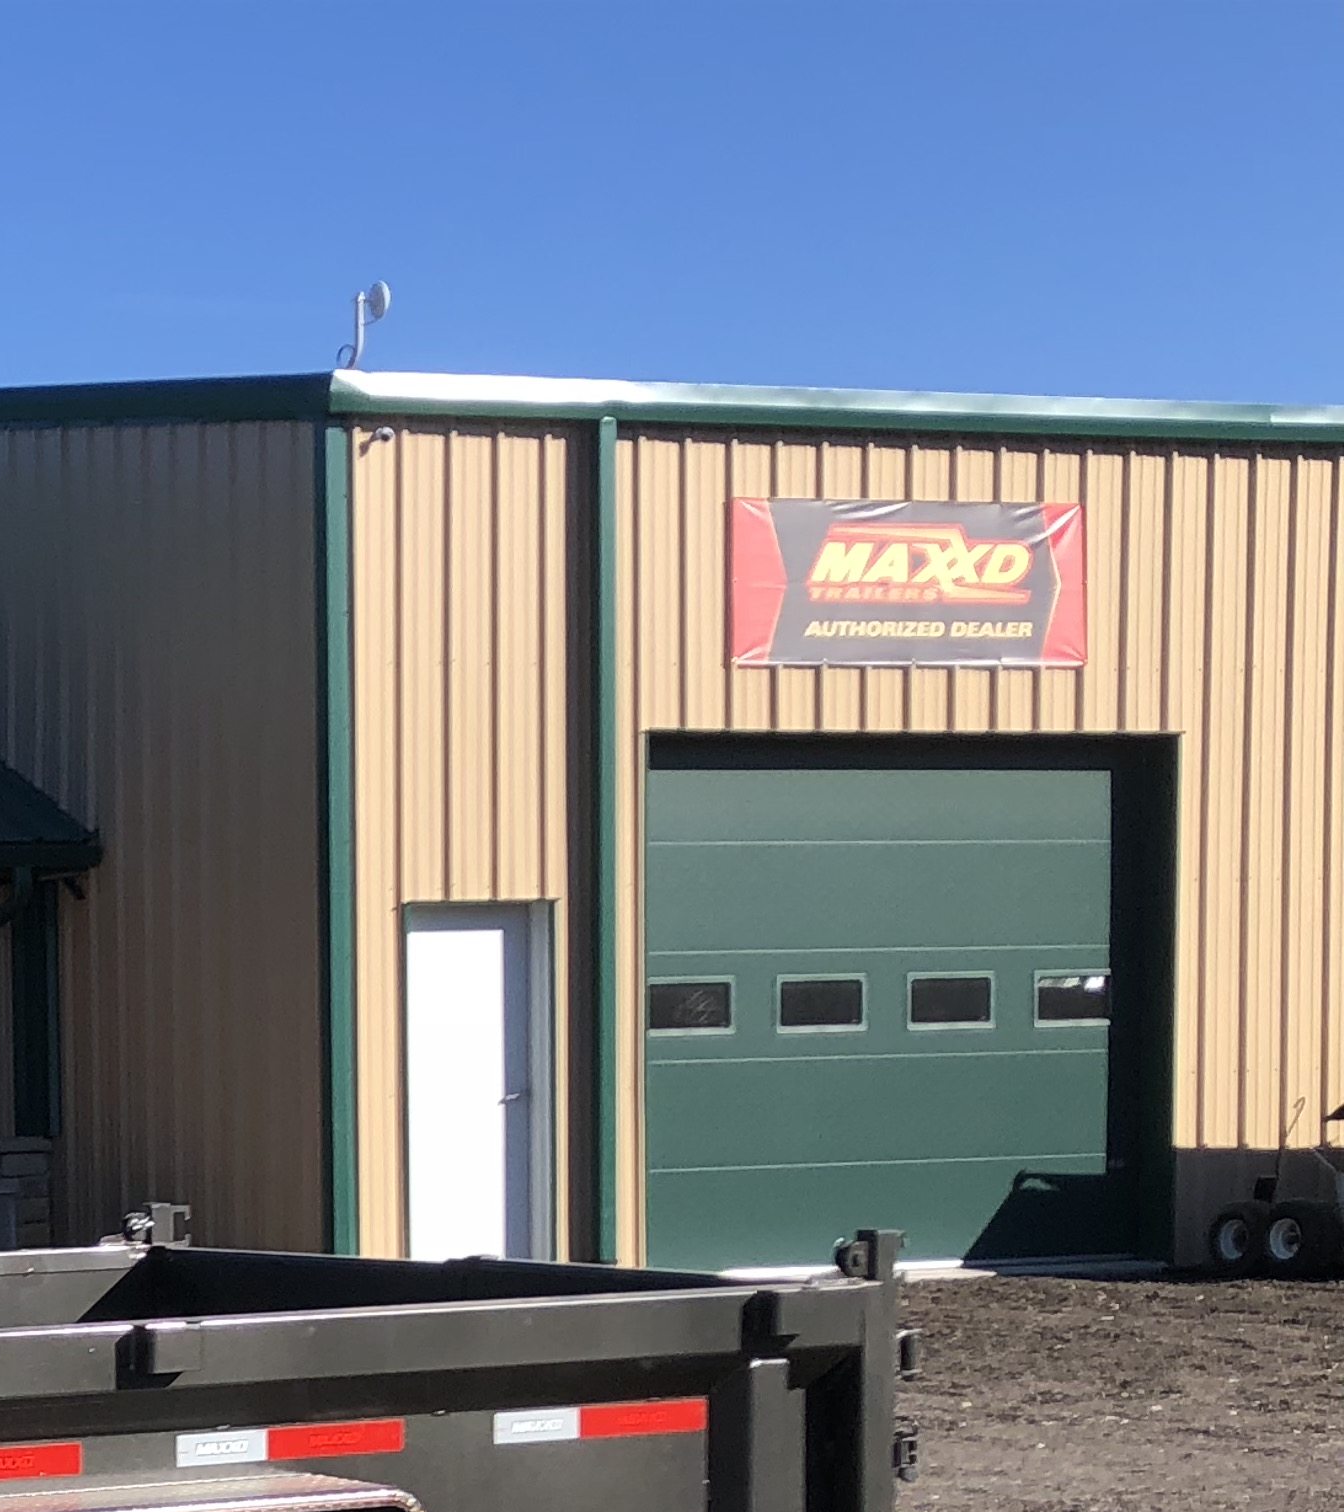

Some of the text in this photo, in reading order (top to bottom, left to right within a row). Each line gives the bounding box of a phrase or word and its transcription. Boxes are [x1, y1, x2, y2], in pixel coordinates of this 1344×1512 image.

[811, 537, 1031, 587] MAXXD
[810, 586, 940, 601] TRAILERS
[805, 620, 1034, 638] AUTHORIZED DEALER
